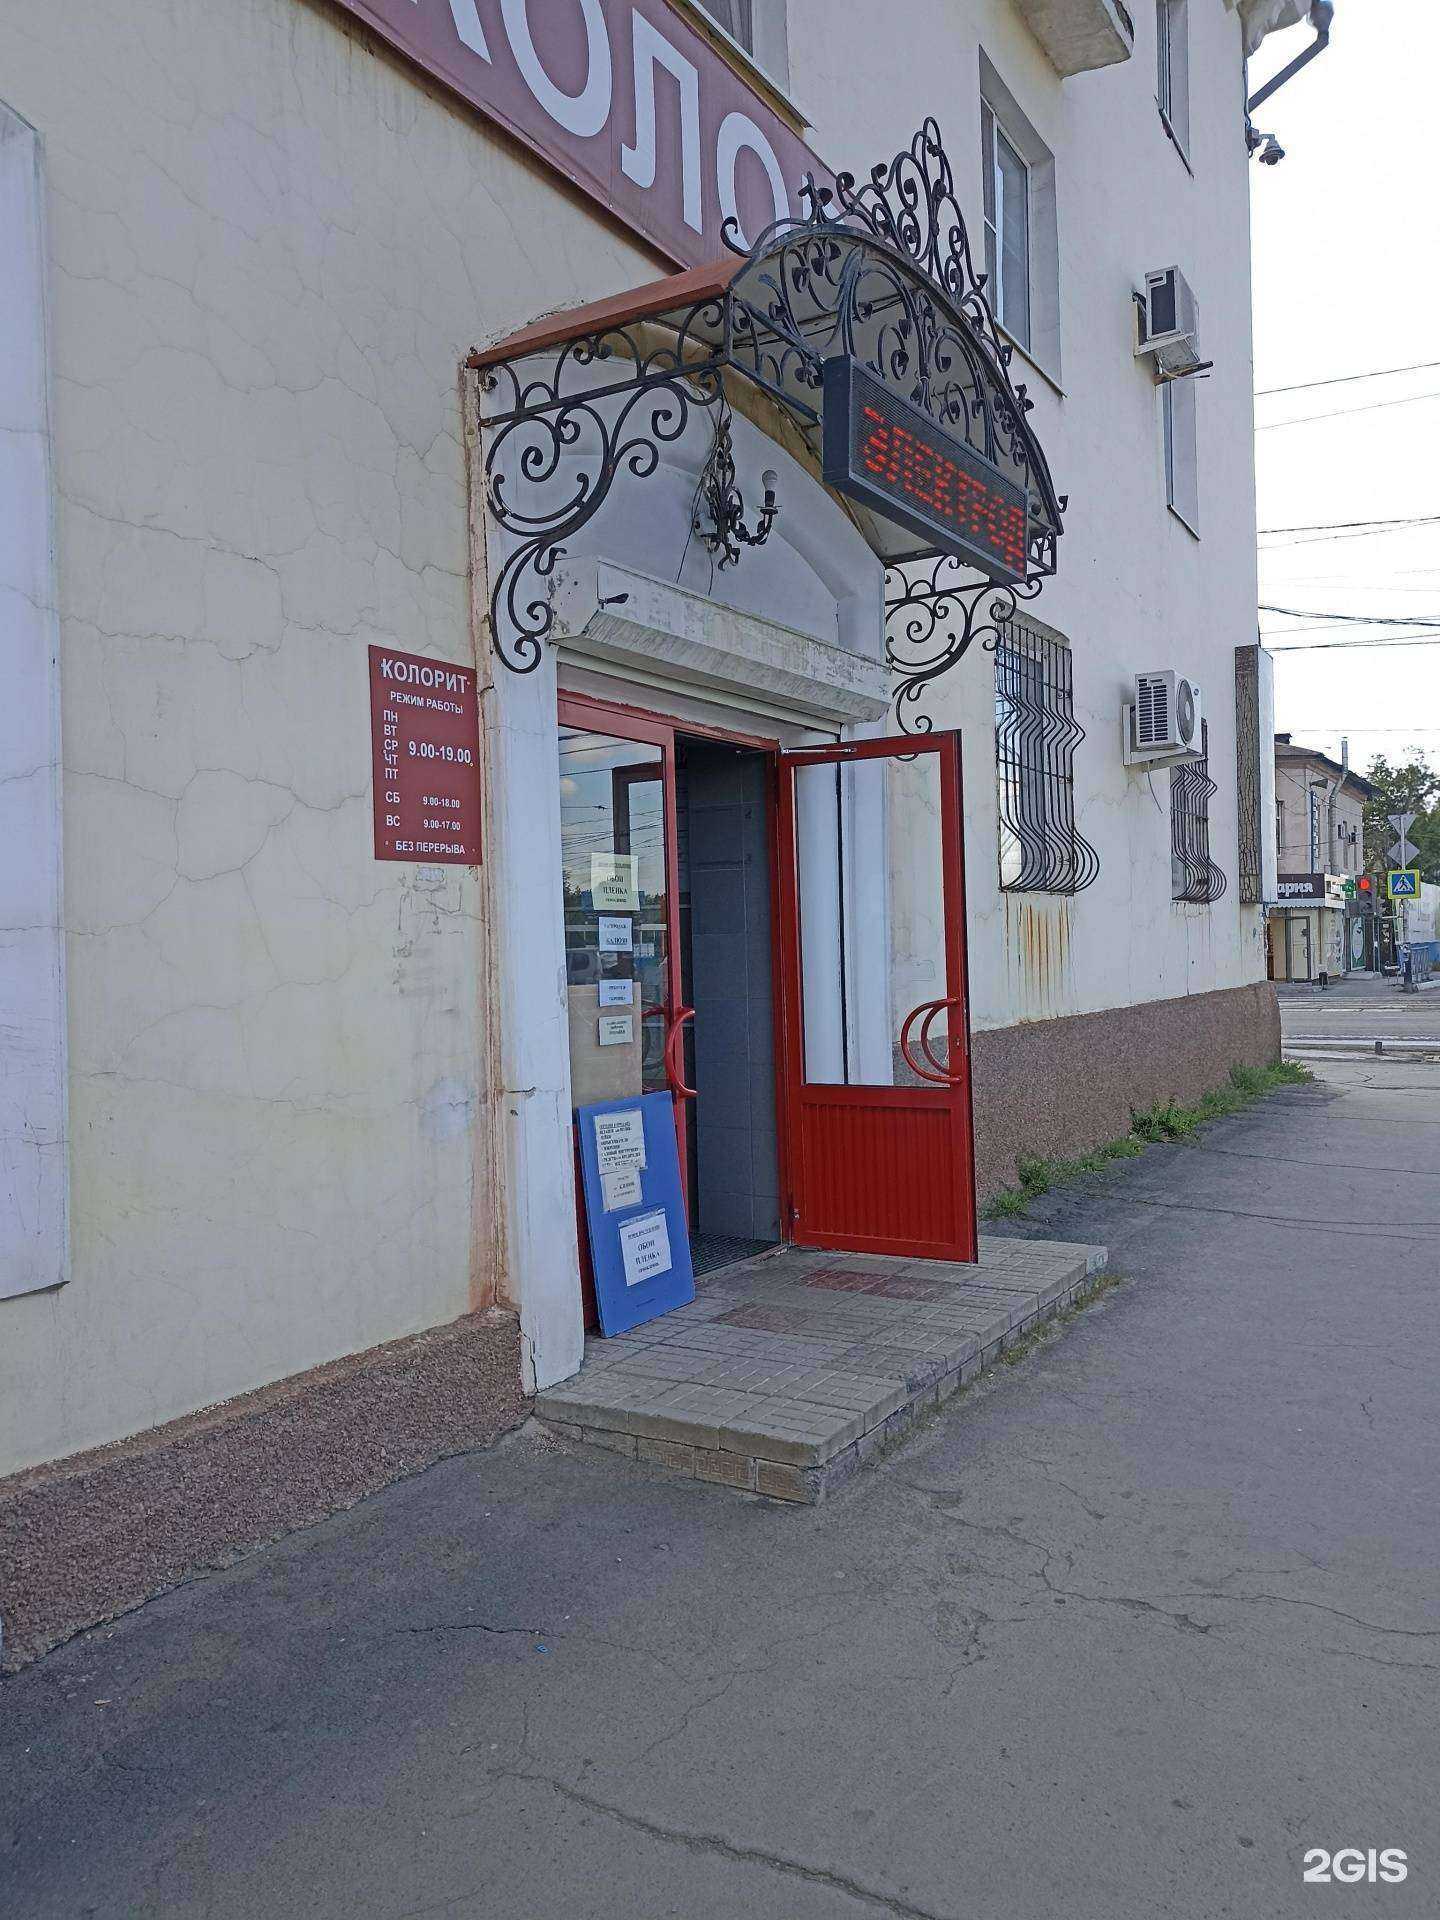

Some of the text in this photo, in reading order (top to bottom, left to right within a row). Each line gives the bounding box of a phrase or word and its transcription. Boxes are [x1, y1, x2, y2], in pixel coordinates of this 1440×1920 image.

[382, 658, 467, 694] КОЛОРИТ
[390, 691, 464, 714] РЕЖИМ РАБОТЫ
[383, 710, 398, 723] ПН
[384, 724, 397, 737] ВТ
[384, 739, 399, 751] СР
[408, 740, 471, 764] 9.00-19.00
[384, 753, 398, 765] ЧТ
[385, 768, 398, 779] ПТ
[386, 791, 460, 809] СБ 9.00-18.00
[386, 815, 461, 831] ВС 9.00-17.00
[395, 841, 466, 855] БЕЗ ПЕРЕРЫВА
